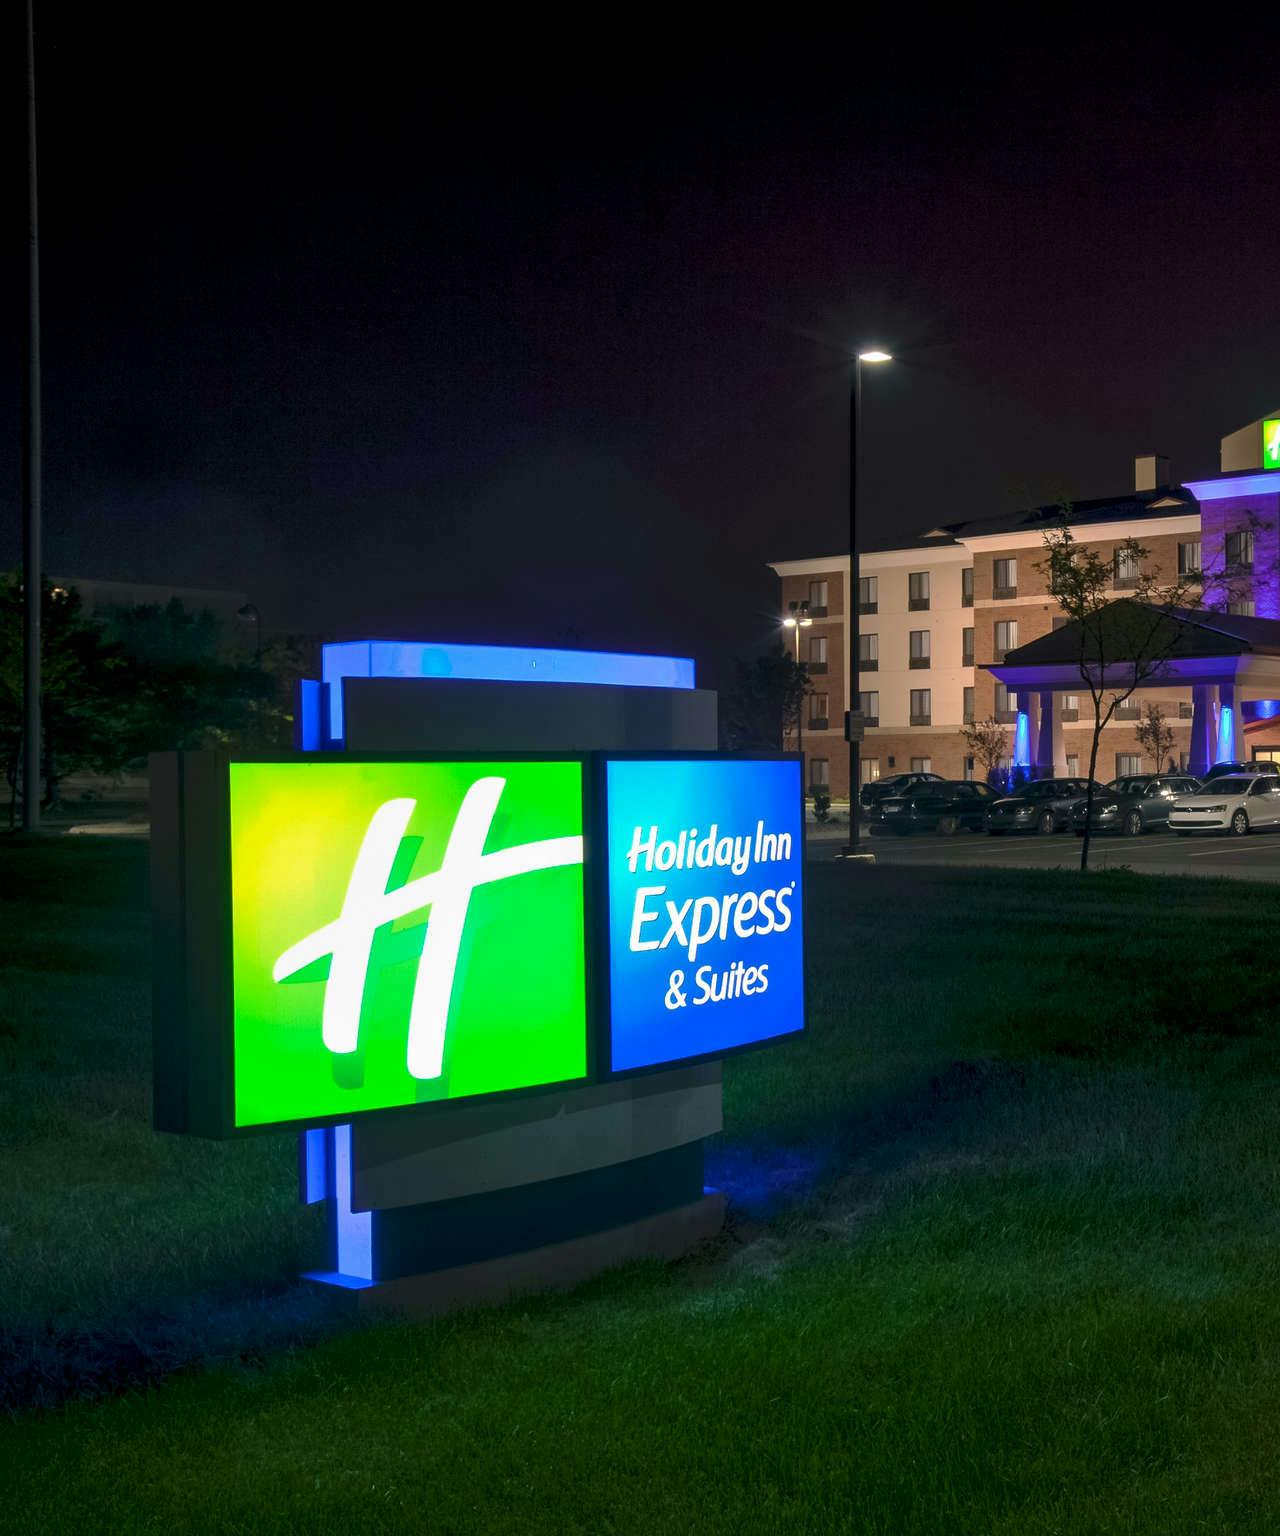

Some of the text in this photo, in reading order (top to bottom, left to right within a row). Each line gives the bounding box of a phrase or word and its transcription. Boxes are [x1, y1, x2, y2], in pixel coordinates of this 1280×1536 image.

[626, 820, 792, 876] Holiday Inn
[629, 883, 793, 962] Express
[664, 960, 769, 1010] & Suites
